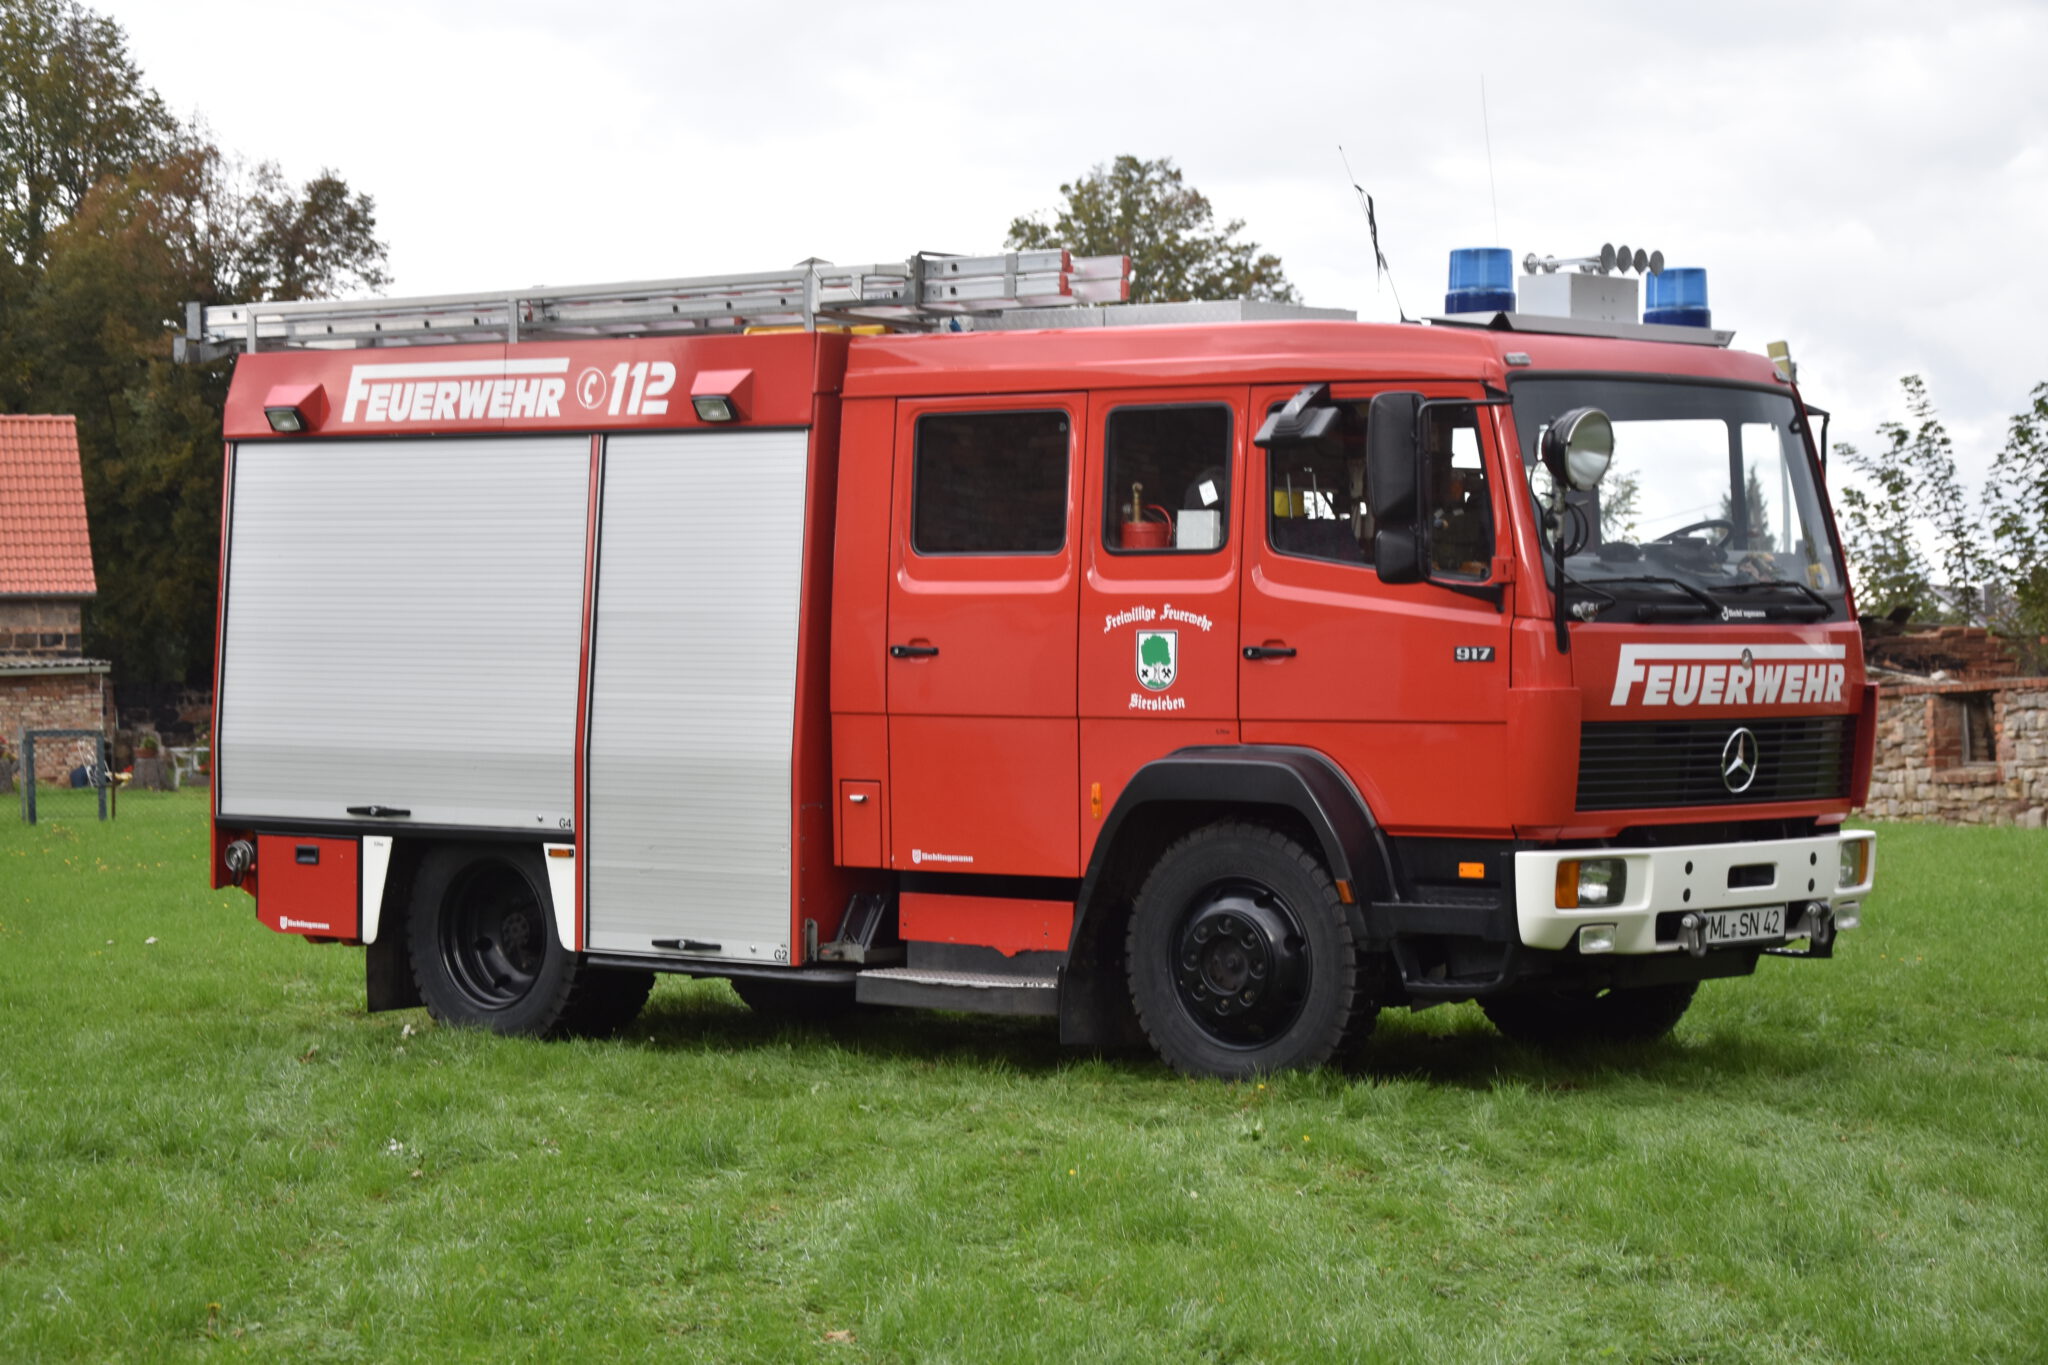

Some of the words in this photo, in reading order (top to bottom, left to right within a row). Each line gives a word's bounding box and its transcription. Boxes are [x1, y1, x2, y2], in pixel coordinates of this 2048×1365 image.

[341, 358, 570, 423] FEUERWEHR
[606, 361, 676, 415] 112
[1103, 605, 1156, 633] Freiwillige
[1160, 603, 1212, 632] Feuerwehr
[1456, 647, 1491, 660] 917
[1610, 643, 1847, 706] FEUERWEHR
[559, 817, 571, 829] G4
[1709, 914, 1730, 939] ML
[1739, 912, 1760, 936] SN
[1763, 909, 1779, 934] 42
[773, 949, 787, 960] G2
